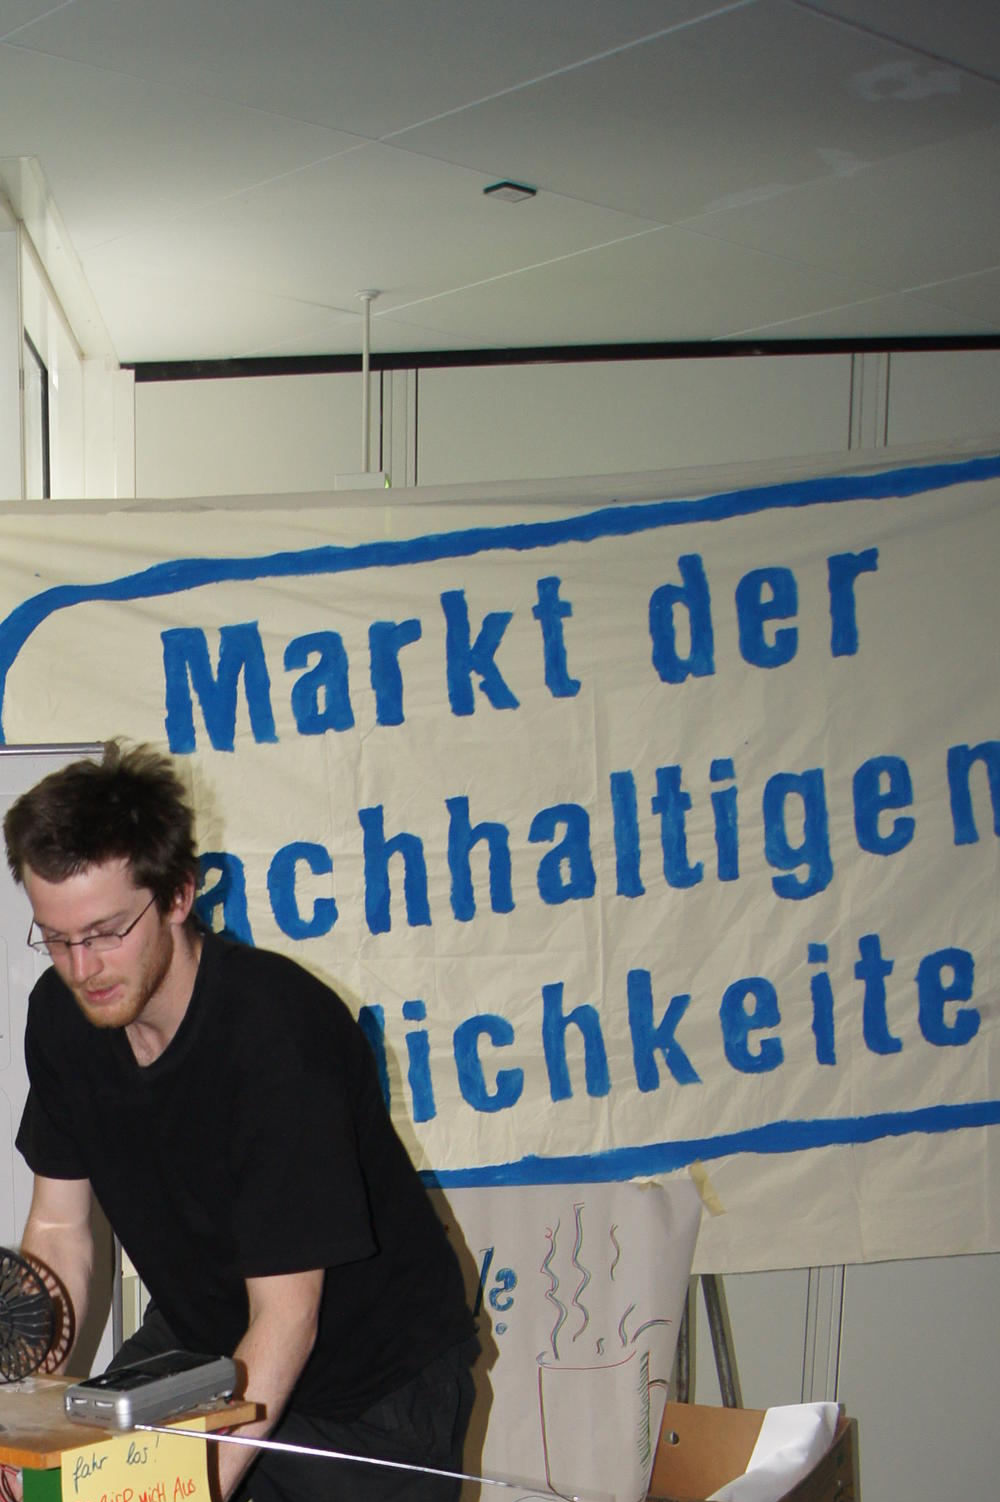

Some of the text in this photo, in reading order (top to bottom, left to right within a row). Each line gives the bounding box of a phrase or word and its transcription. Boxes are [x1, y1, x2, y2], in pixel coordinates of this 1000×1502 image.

[160, 546, 880, 755] Markt der
[195, 740, 1000, 949] achhaltigen
[73, 1452, 109, 1494] fahr
